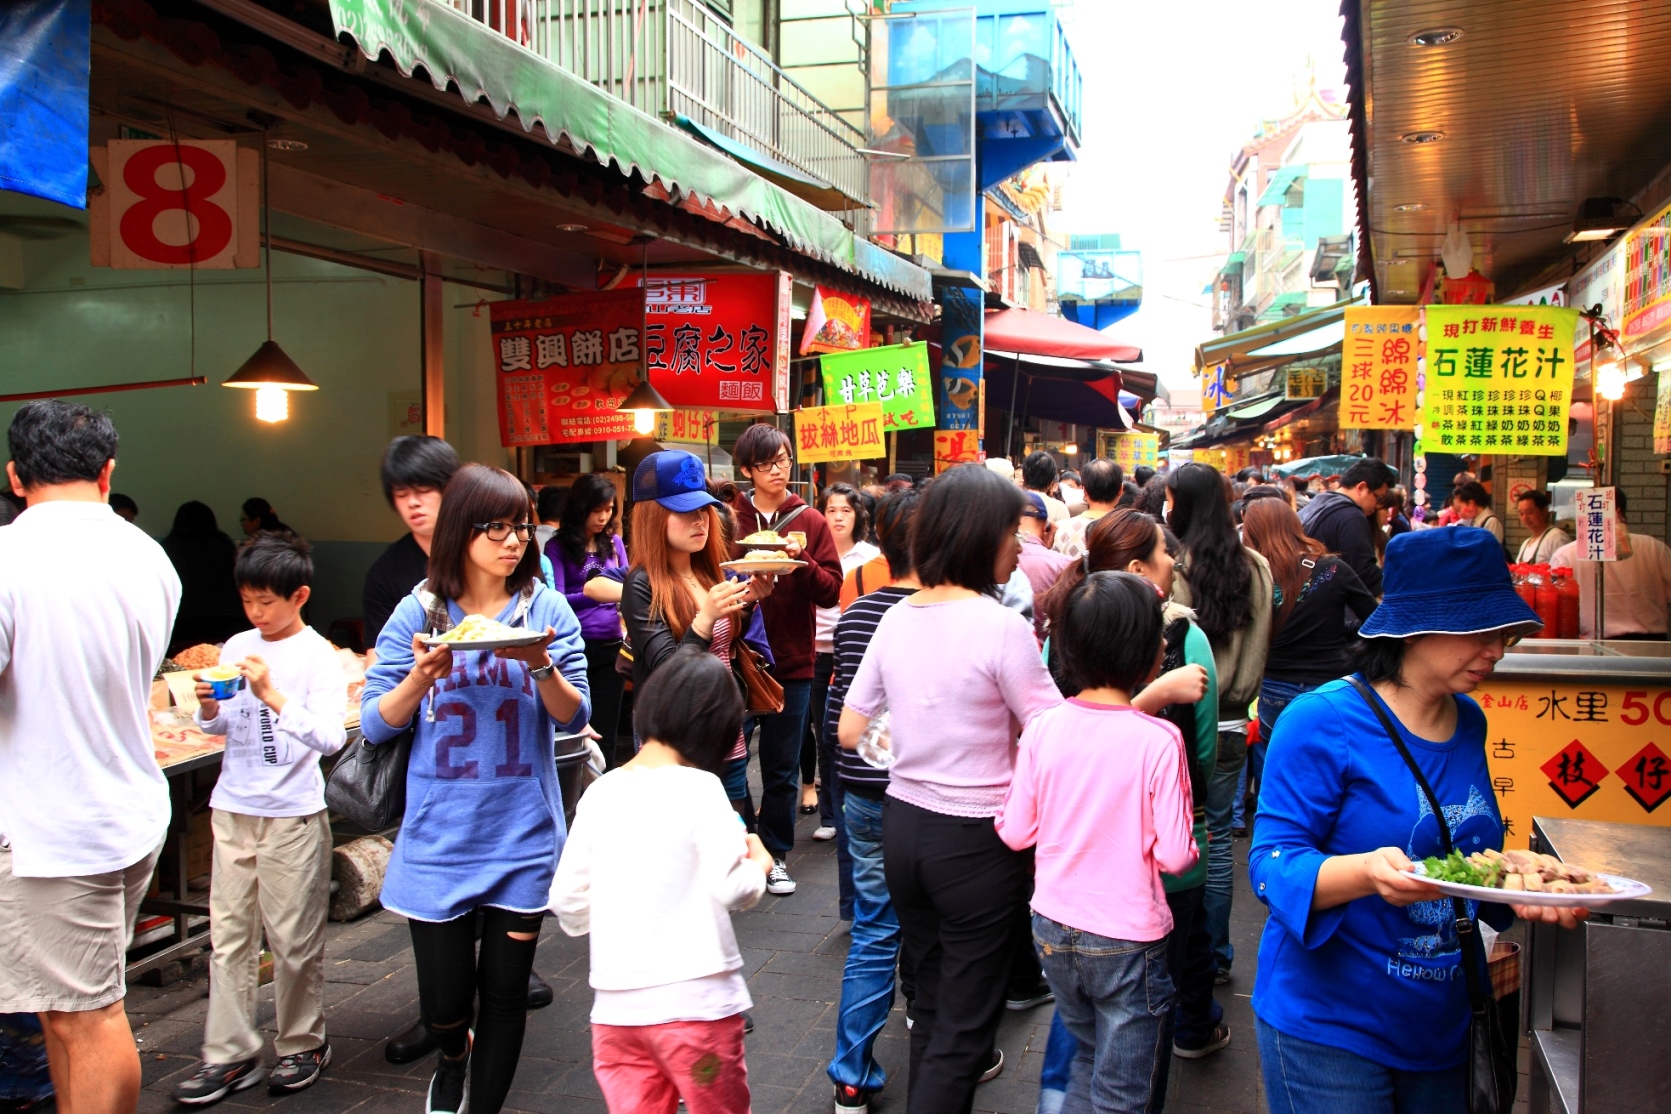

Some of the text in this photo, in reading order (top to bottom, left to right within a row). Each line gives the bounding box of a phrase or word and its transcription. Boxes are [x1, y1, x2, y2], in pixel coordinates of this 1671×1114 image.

[120, 144, 232, 264] 8
[646, 304, 711, 314] 山老店
[1443, 317, 1554, 340] 現打新鮮養生
[500, 327, 640, 372] 雙興餅店
[646, 323, 771, 374] 豆腐之家
[1434, 347, 1565, 379] 石蓮花汁
[720, 382, 762, 399] 麵飯
[838, 366, 916, 404] 甘草芭樂
[1349, 338, 1375, 423] 三球20元
[1378, 338, 1411, 425] 綿綿冰
[800, 419, 880, 450] 拔絲地瓜
[1470, 390, 1484, 446] 珍珠紅茶
[1485, 390, 1500, 446] 珍珠綠茶
[1500, 390, 1516, 446] 珍珠奶茶
[1516, 390, 1531, 447] 珍珠奶綠
[1532, 390, 1546, 447] QQ奶茶
[1587, 494, 1604, 560] 石蓮花汁
[1481, 693, 1529, 711] 金山店
[1536, 690, 1609, 723] 水里
[259, 708, 278, 764] WORLD CUP
[436, 699, 533, 779] 21
